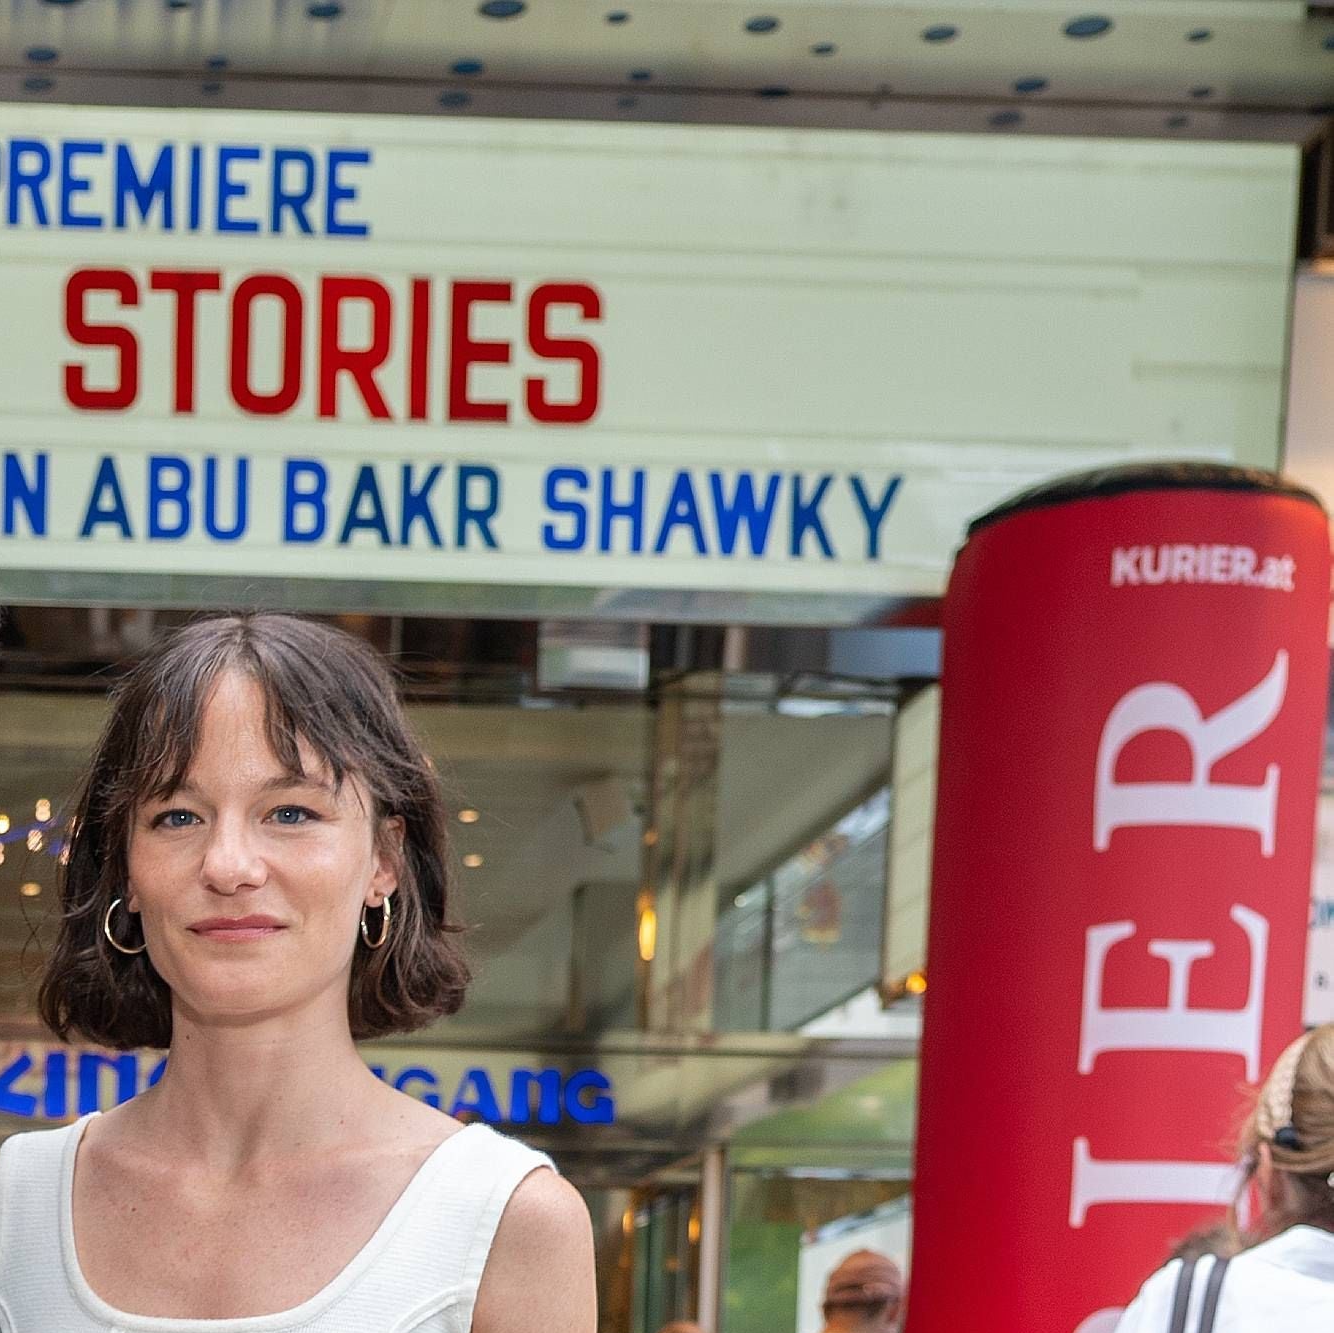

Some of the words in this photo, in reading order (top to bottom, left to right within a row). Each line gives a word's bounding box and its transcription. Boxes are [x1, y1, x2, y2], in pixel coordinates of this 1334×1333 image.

[63, 267, 603, 425] STORIES
[80, 455, 251, 544] ABU
[281, 457, 502, 551] BAKR
[540, 464, 903, 561] SHAWKY
[1111, 544, 1297, 592] KURIER.at
